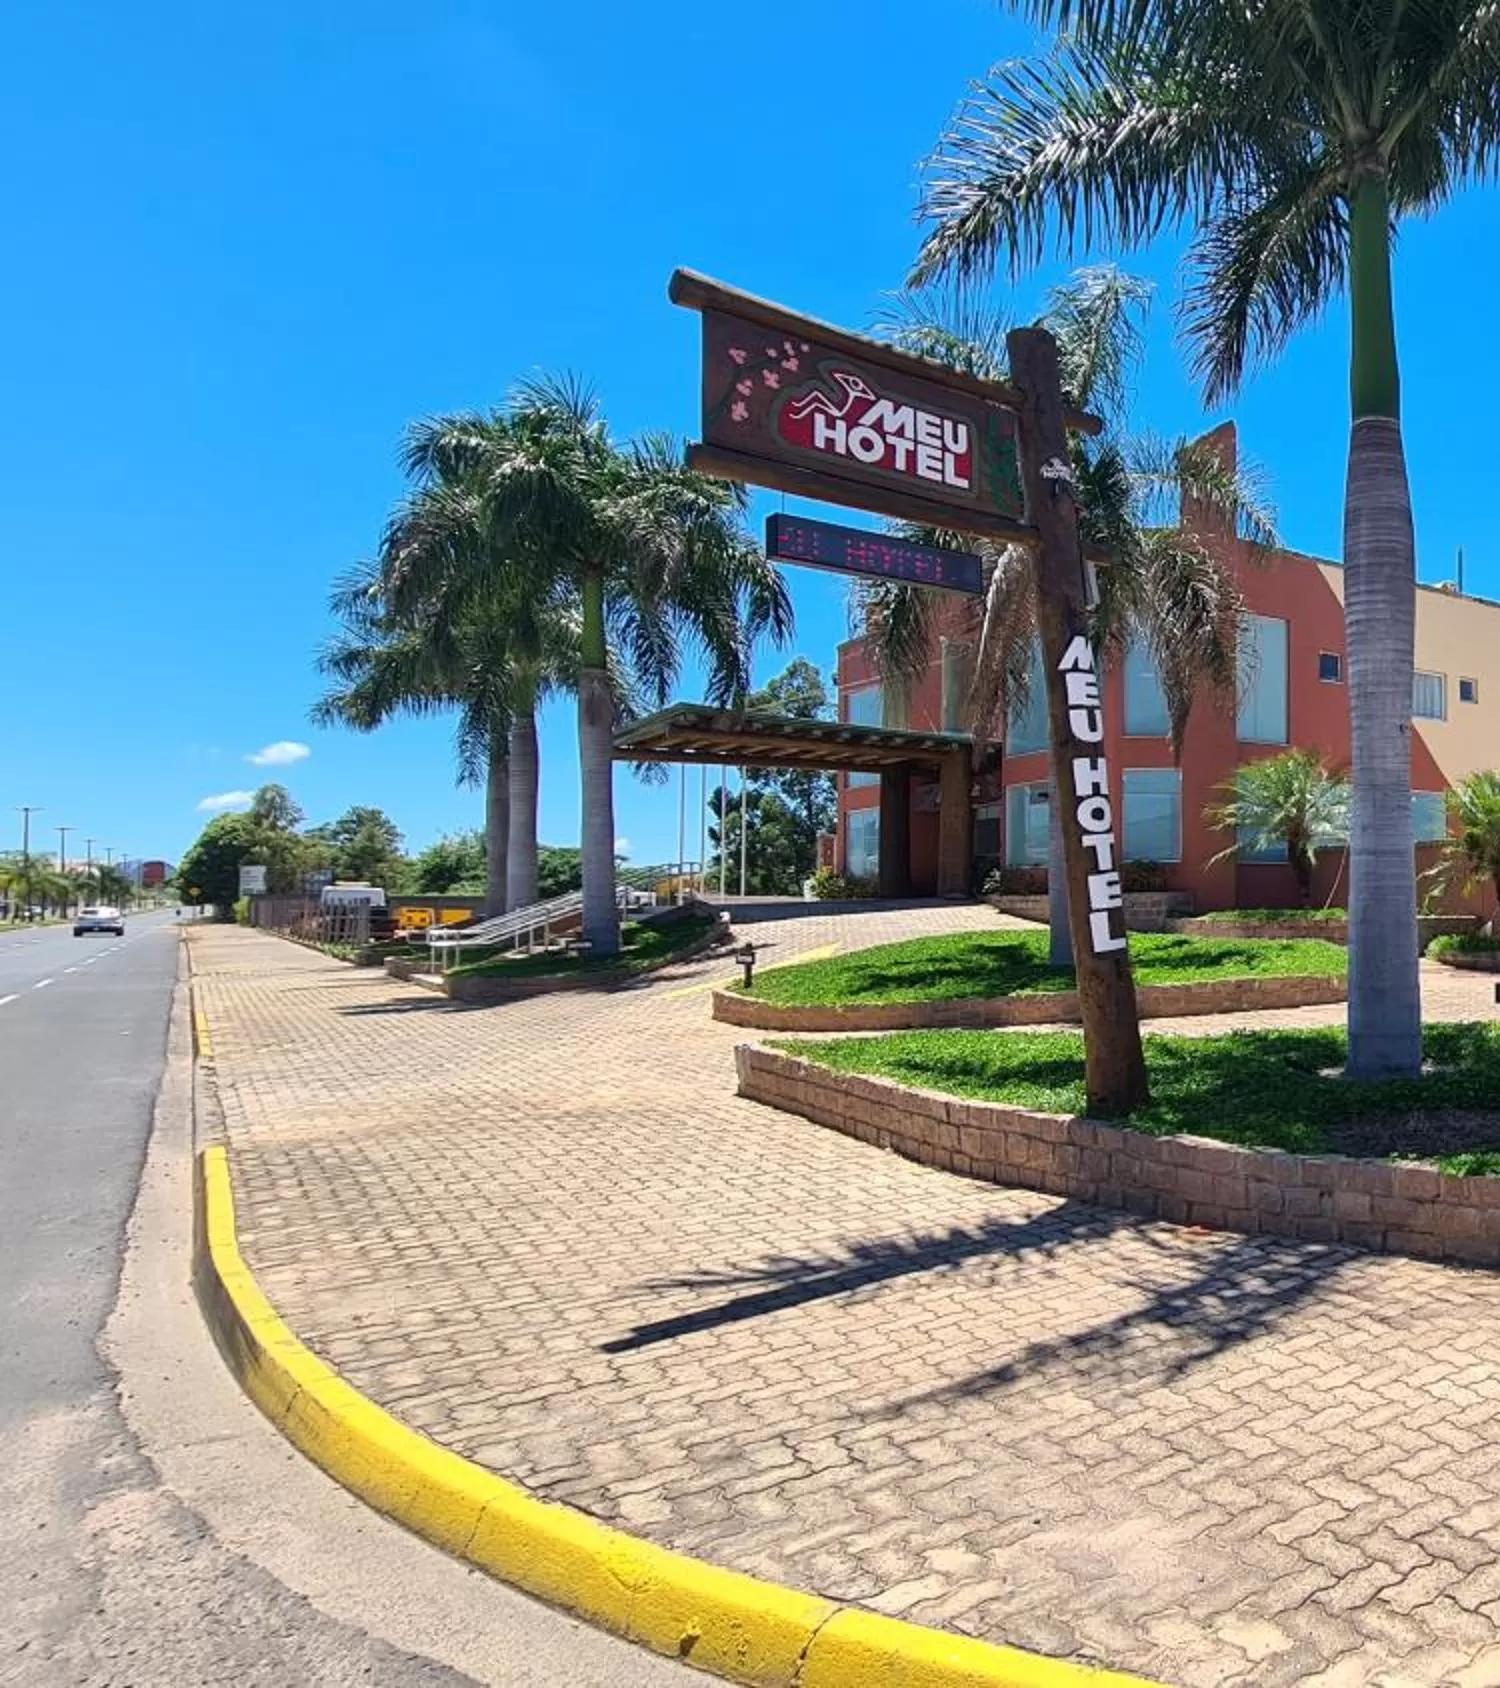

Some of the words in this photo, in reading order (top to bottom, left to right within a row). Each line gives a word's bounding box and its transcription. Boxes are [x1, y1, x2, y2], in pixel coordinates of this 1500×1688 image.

[814, 412, 969, 489] HOTEL
[858, 399, 968, 455] MEU
[1057, 635, 1104, 743] MEU
[1072, 757, 1127, 953] HOTEL
